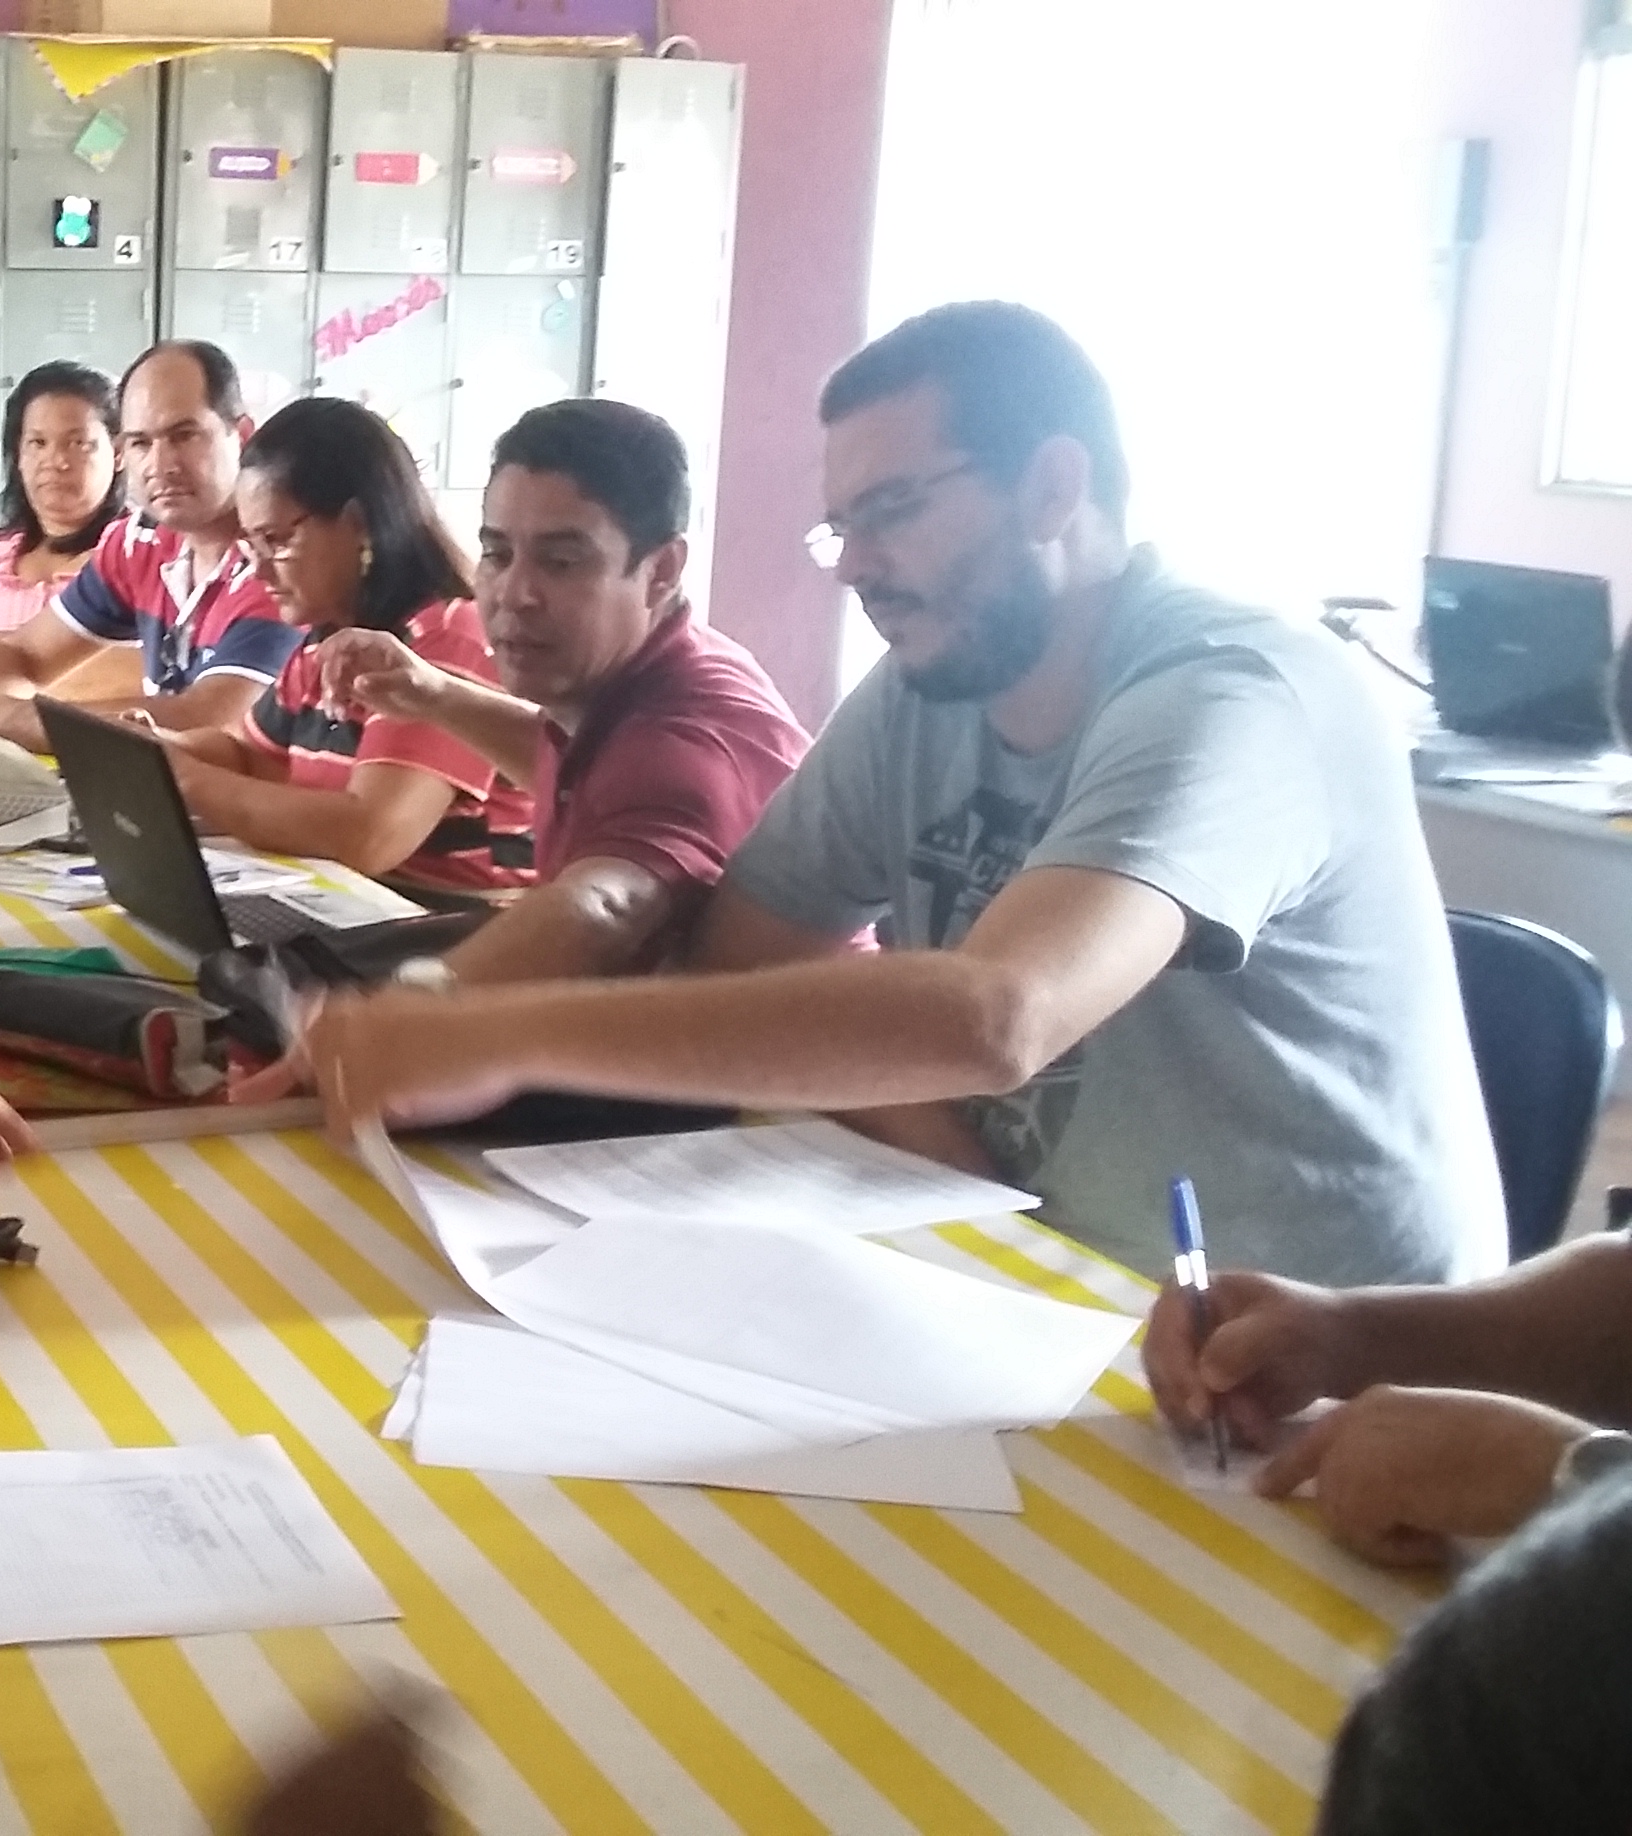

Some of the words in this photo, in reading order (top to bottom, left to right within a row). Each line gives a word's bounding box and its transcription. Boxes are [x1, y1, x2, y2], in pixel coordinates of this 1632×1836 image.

[117, 239, 134, 259] 4
[270, 241, 303, 261] 17
[551, 244, 581, 265] 19
